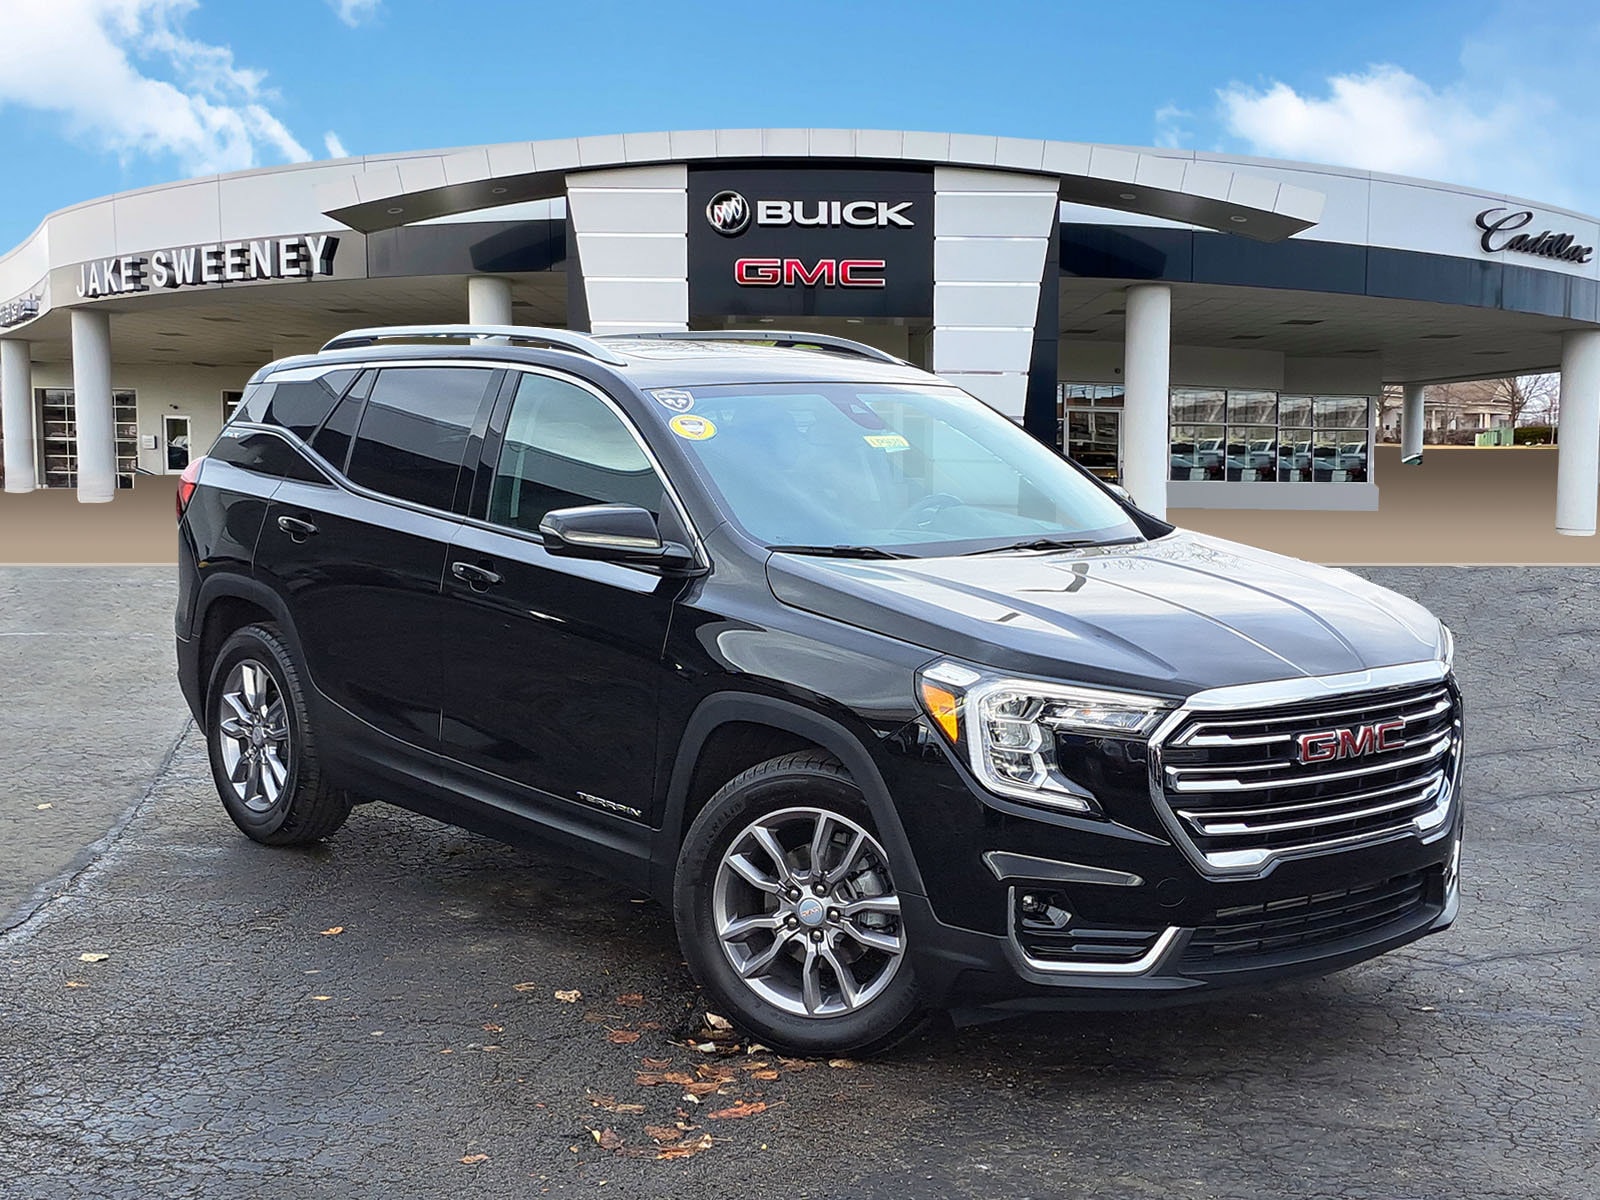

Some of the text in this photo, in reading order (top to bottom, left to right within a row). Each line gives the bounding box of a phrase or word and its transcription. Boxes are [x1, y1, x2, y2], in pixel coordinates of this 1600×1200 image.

[757, 200, 915, 226] BUICK
[1475, 207, 1593, 264] Cadillac
[76, 234, 331, 298] JAKE SWEENEY
[735, 257, 886, 287] GMC
[1298, 717, 1406, 765] GMC
